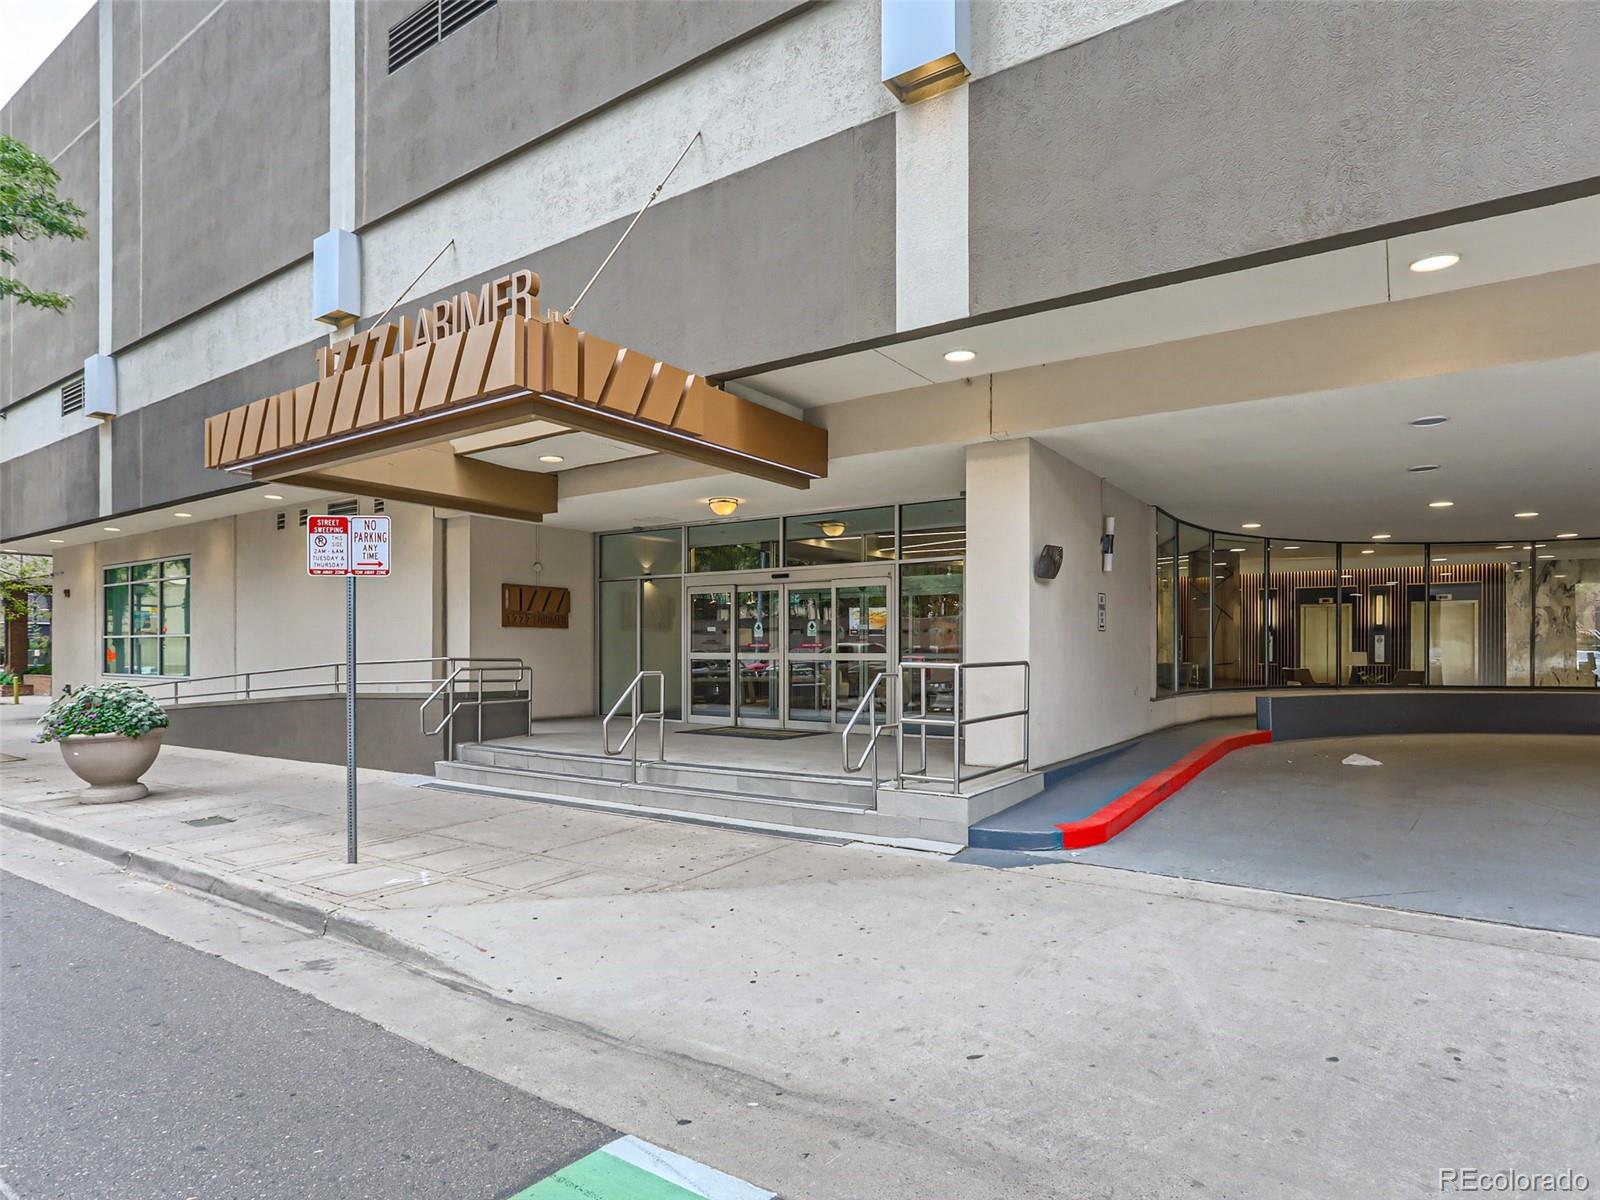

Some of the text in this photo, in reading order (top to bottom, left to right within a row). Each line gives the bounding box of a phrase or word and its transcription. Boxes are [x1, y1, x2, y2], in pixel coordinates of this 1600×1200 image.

[316, 268, 541, 378] 1777 LARIMER
[364, 520, 377, 531] NO
[354, 532, 387, 543] PARKING
[363, 552, 378, 560] TIME
